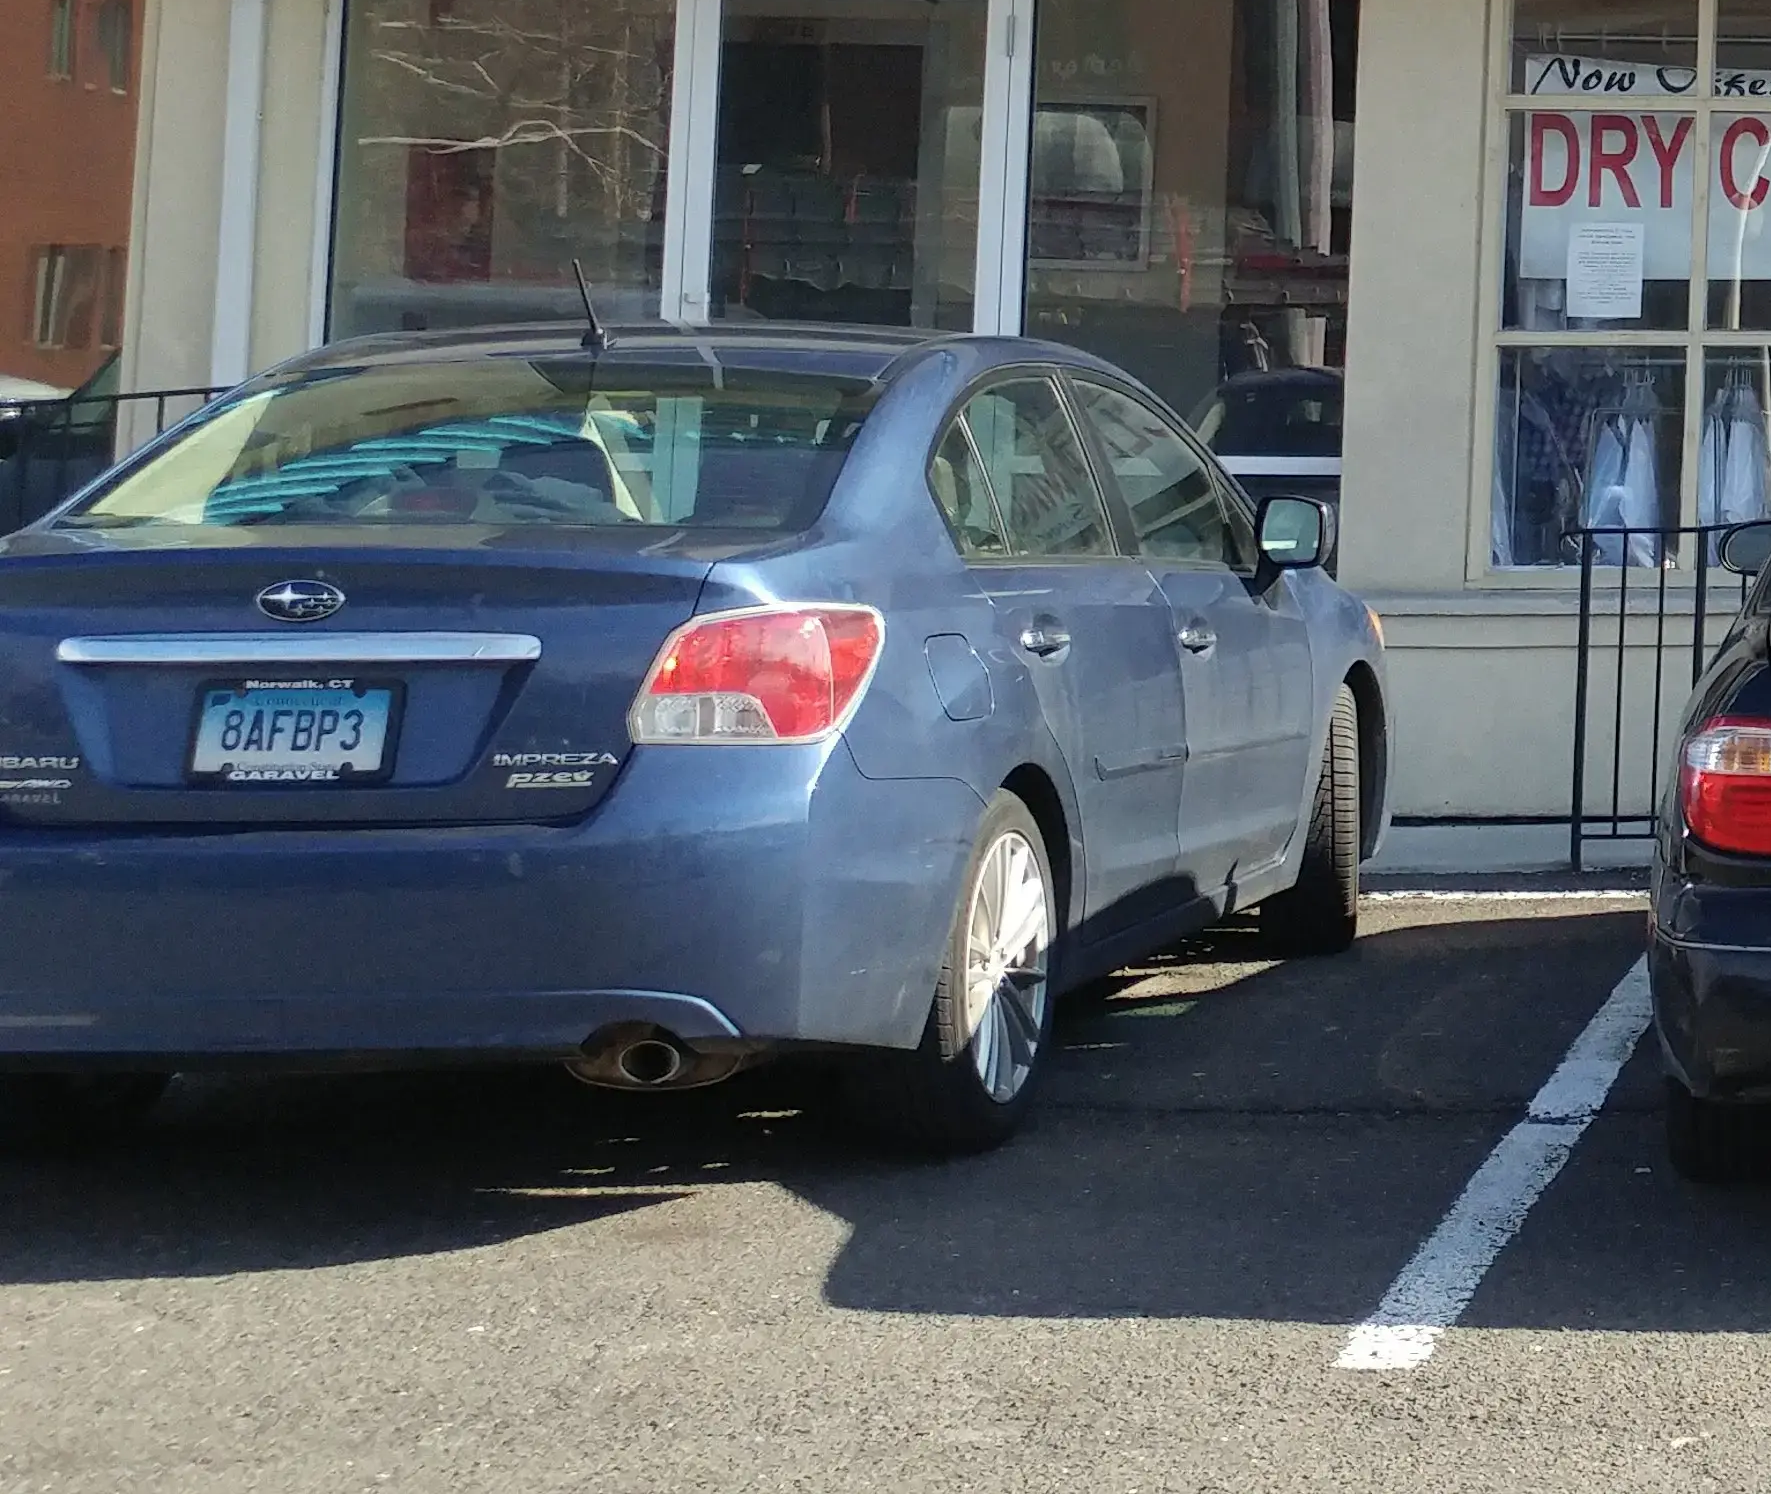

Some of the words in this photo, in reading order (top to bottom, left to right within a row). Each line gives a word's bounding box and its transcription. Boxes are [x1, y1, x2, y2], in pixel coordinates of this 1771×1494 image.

[1531, 57, 1636, 96] Now
[1528, 112, 1696, 208] DRY
[244, 680, 324, 690] Norwalk,
[328, 679, 355, 689] CT
[220, 709, 365, 752] 8AFBP3
[0, 757, 80, 770] BARU
[492, 752, 619, 767] IMPREZA
[228, 770, 340, 781] GARAVEL
